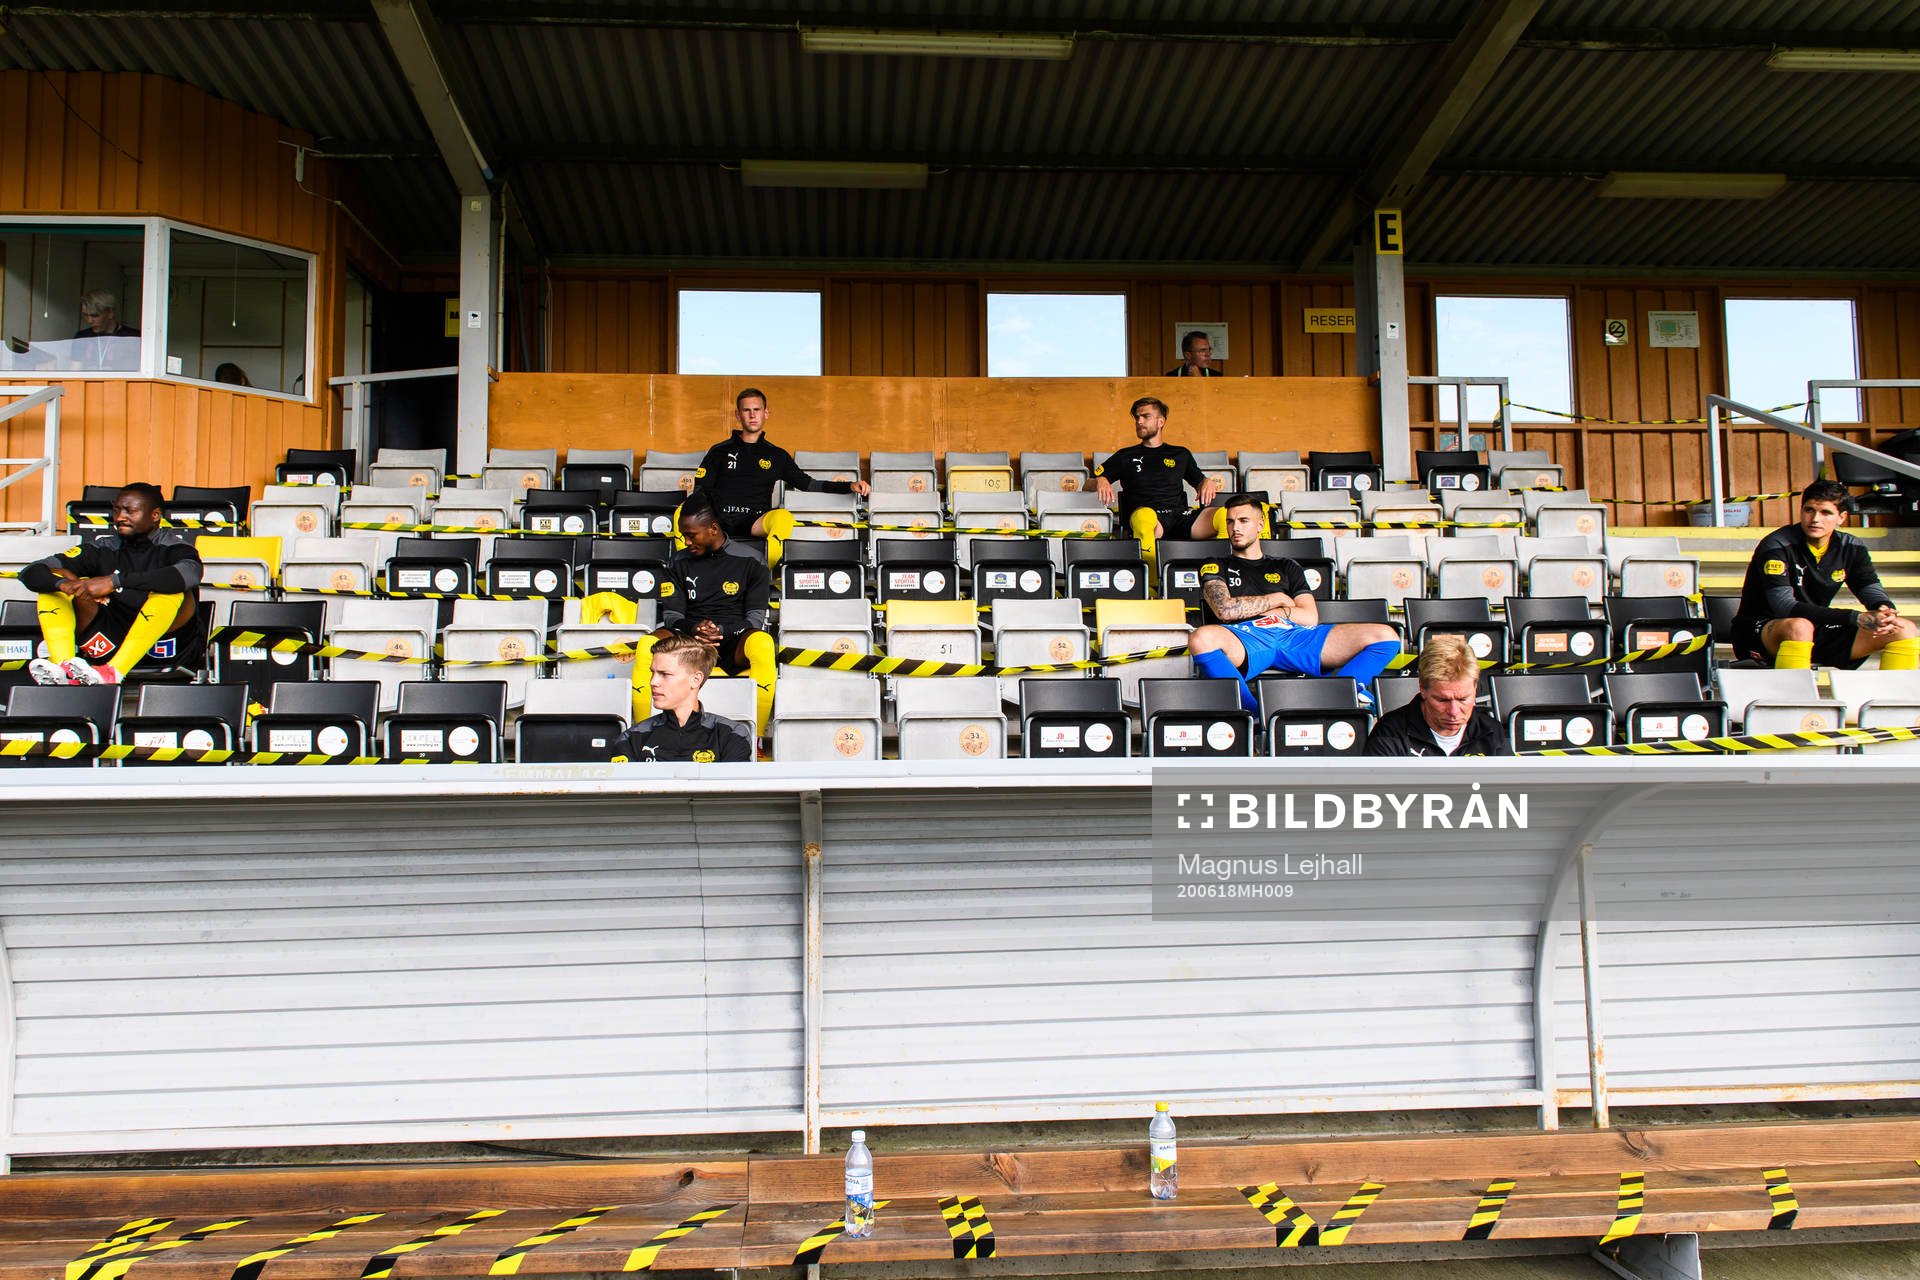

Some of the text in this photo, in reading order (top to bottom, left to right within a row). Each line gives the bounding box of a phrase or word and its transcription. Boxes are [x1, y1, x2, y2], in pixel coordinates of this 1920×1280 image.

[1378, 213, 1399, 251] E
[1310, 315, 1355, 326] RESER
[727, 460, 737, 469] 21
[1136, 464, 1142, 473] 3
[1229, 577, 1242, 587] 30
[687, 589, 697, 600] 10
[940, 643, 953, 654] 51
